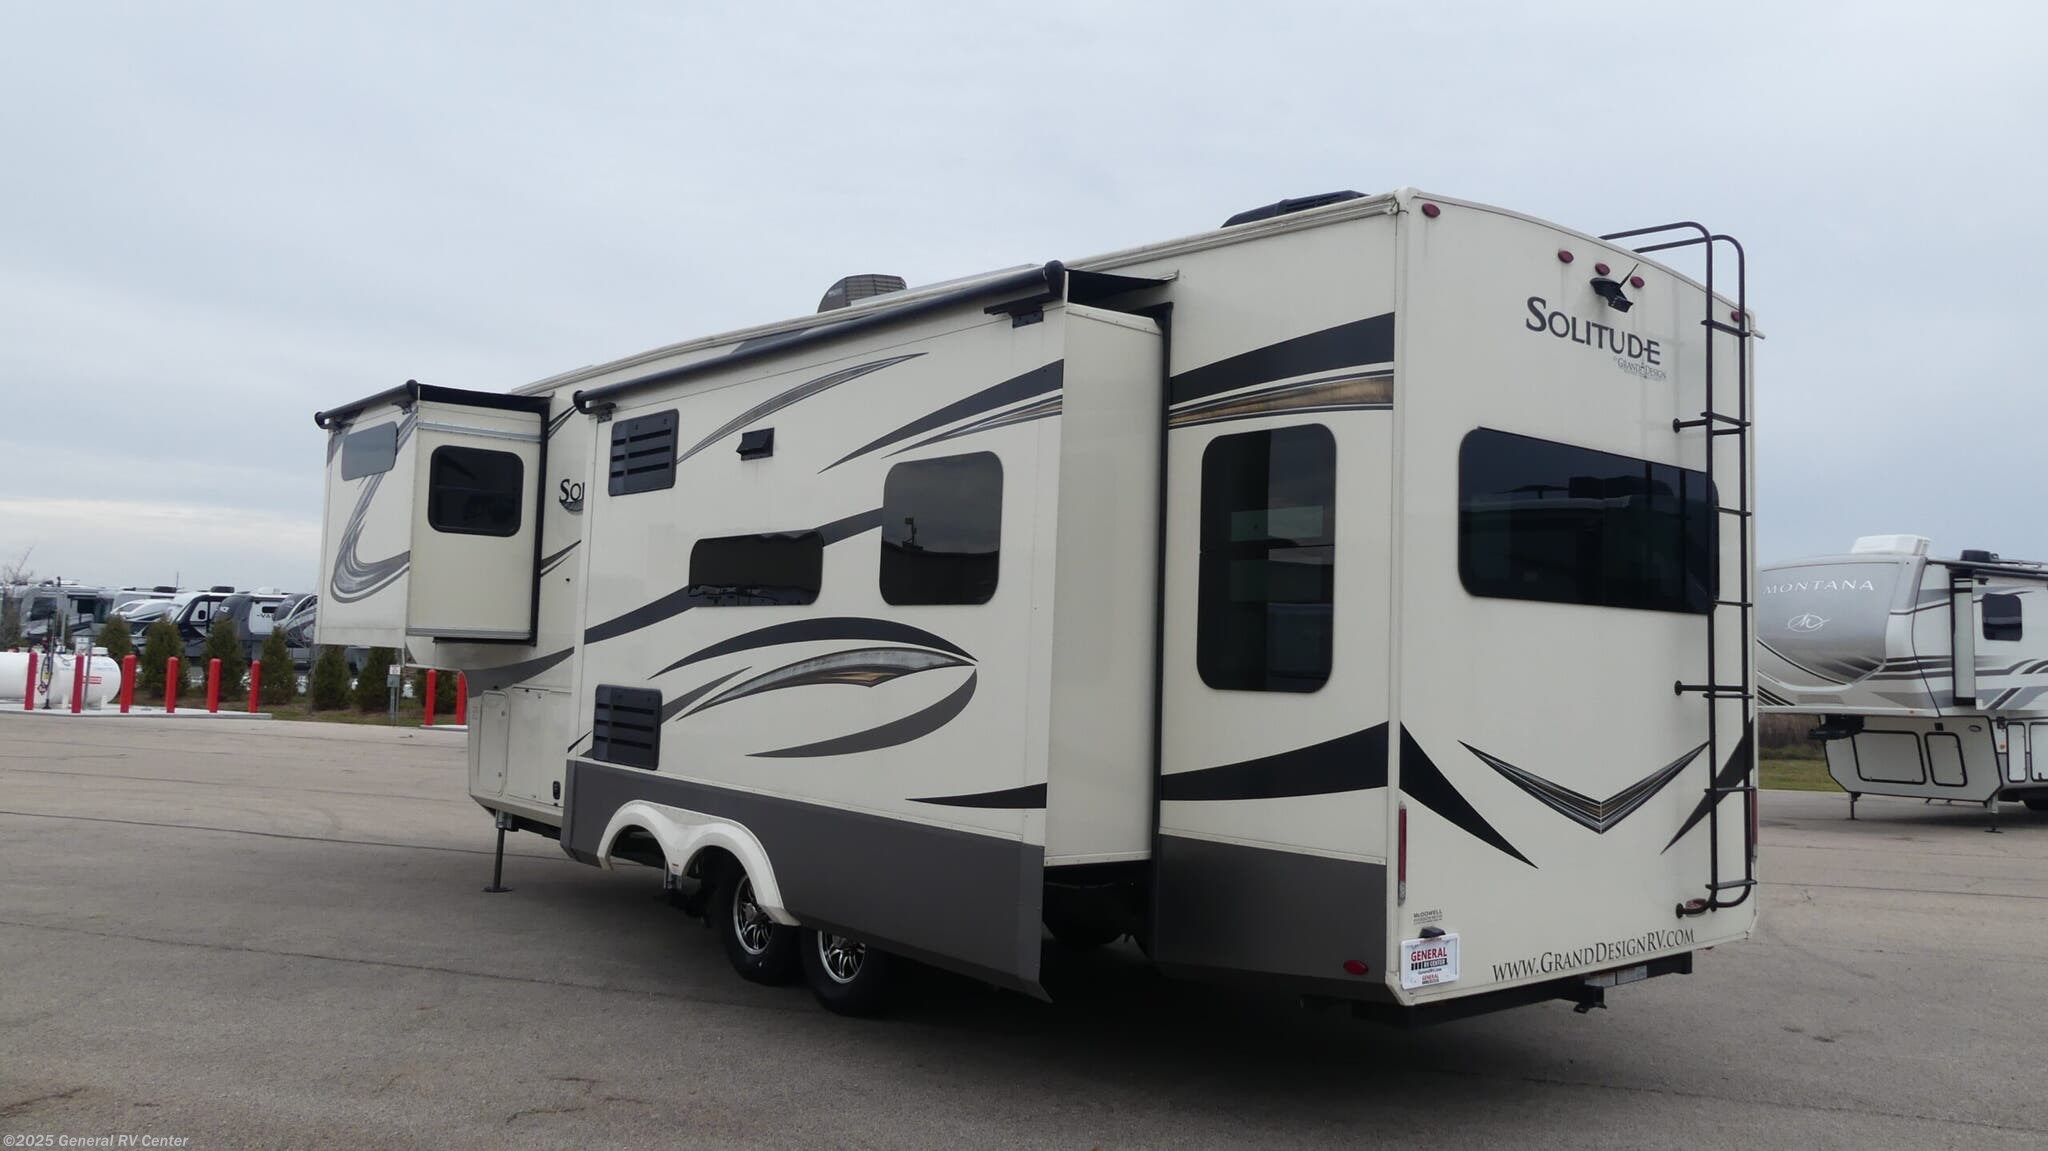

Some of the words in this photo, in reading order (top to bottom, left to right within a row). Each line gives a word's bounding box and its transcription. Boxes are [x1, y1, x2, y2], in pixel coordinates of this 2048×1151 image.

[1526, 296, 1661, 366] SOLITUDE
[1763, 580, 1874, 594] MONTANA
[1411, 947, 1447, 962] GENERAL
